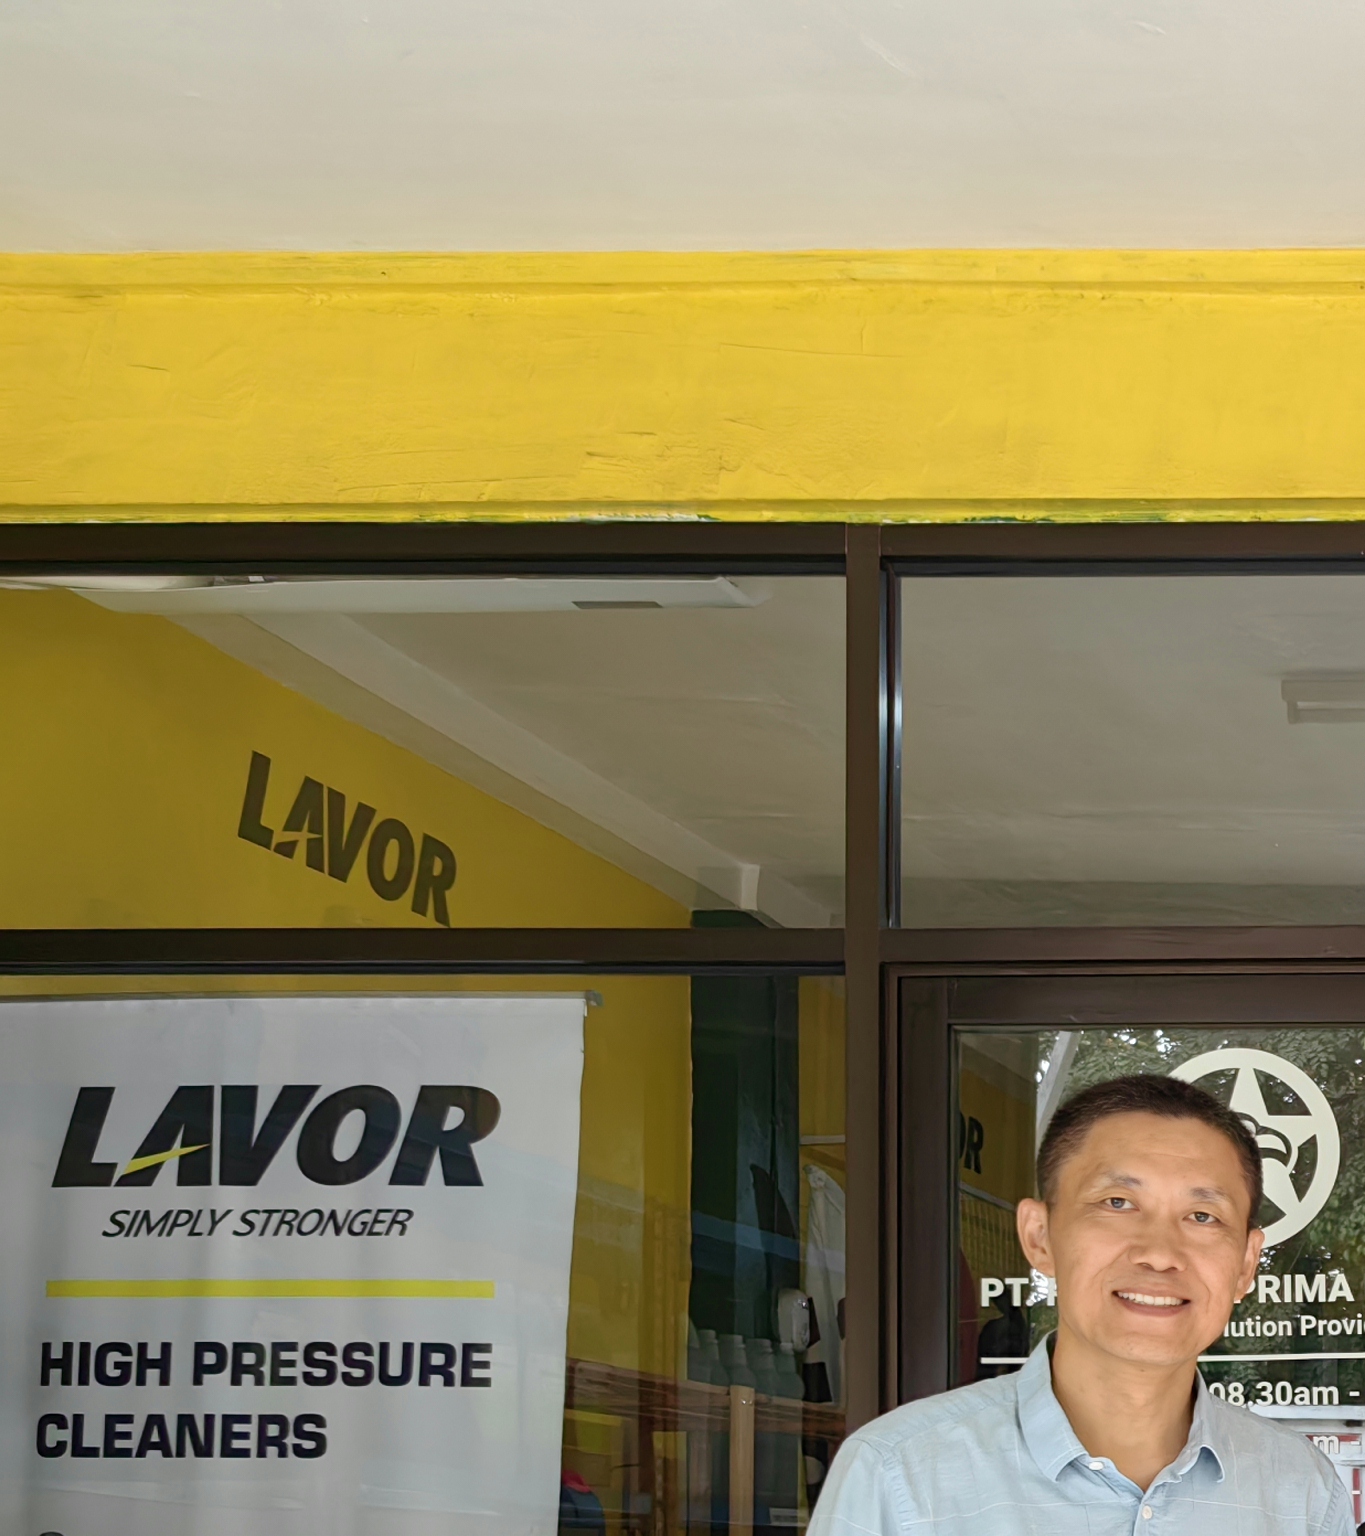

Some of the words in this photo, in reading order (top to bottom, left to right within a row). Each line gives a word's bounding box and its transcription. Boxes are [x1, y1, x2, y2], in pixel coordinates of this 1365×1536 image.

[237, 750, 458, 928] LAVOR
[51, 1084, 501, 1187] LAVOR
[102, 1208, 233, 1238] SIMPLY
[233, 1208, 415, 1238] STRONGER
[40, 1341, 172, 1387] HIGH
[193, 1341, 493, 1388] PRESSURE
[1208, 1381, 1339, 1407] 08.30am
[36, 1413, 328, 1459] CLEANERS
